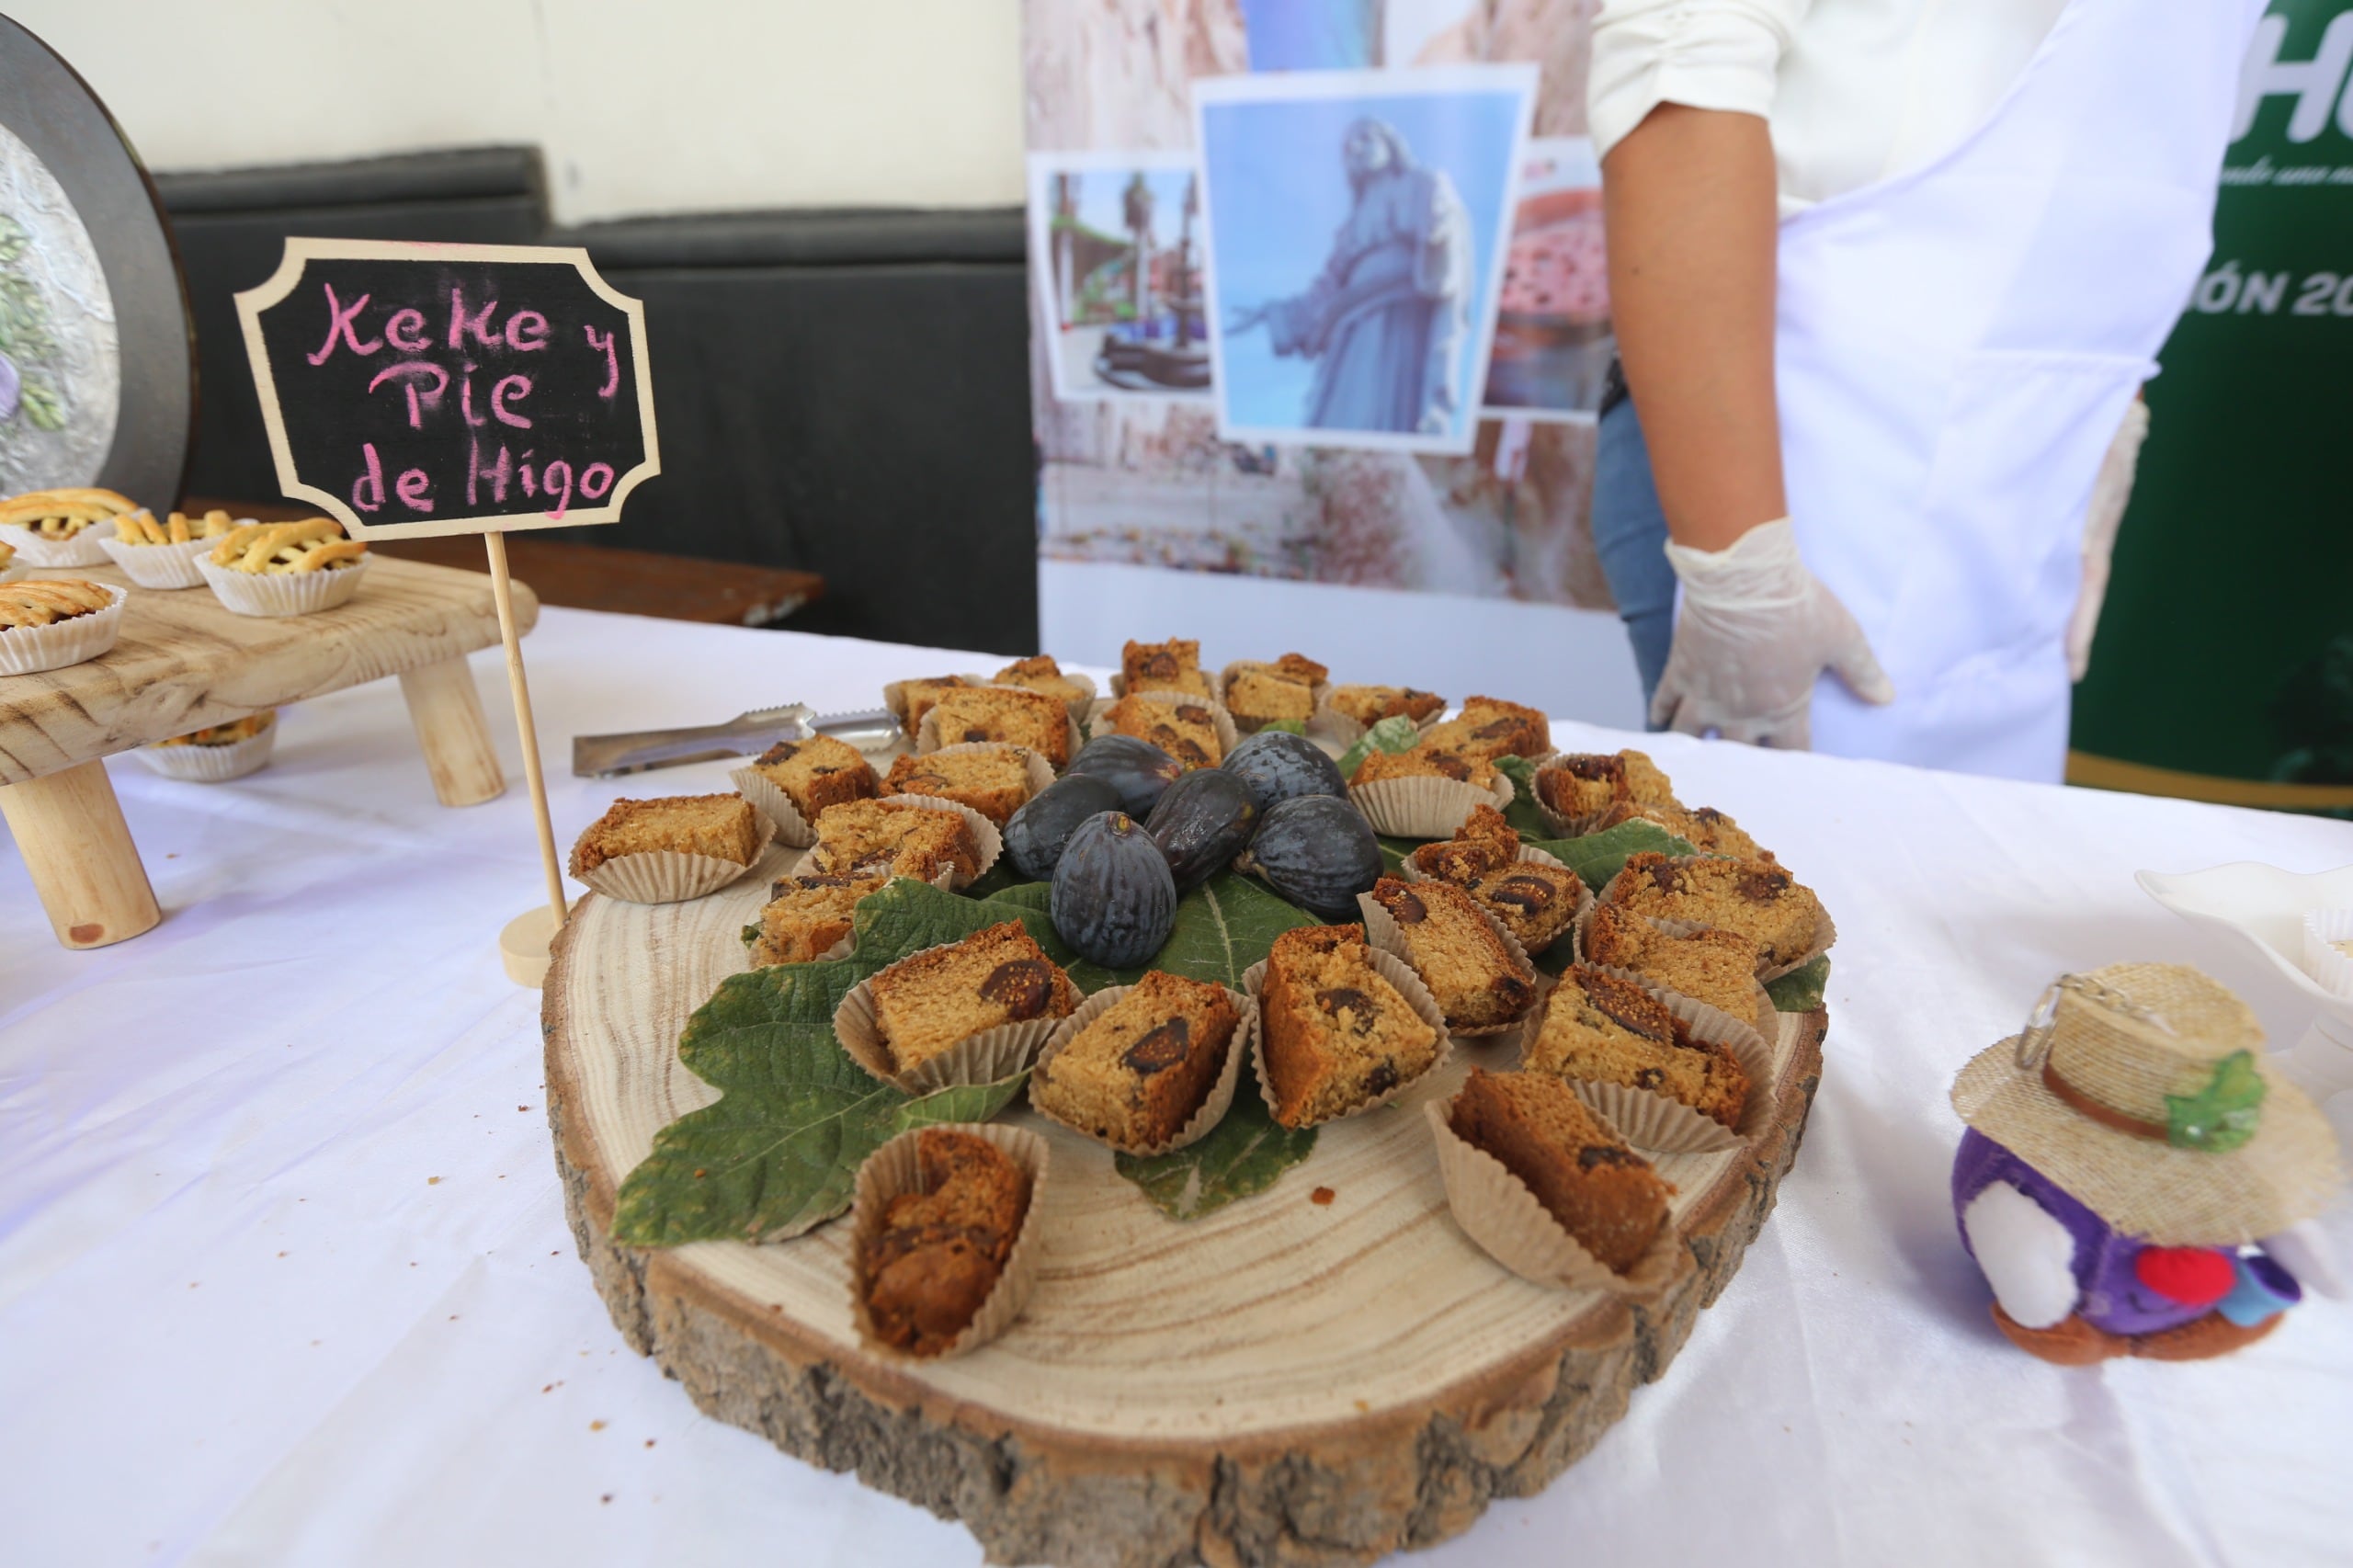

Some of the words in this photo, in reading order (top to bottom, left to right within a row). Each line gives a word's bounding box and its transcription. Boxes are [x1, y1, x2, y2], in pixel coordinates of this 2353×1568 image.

[2191, 260, 2290, 314] ÓN
[369, 361, 533, 430] Pie
[352, 442, 434, 512] de
[467, 436, 615, 519] Higo
